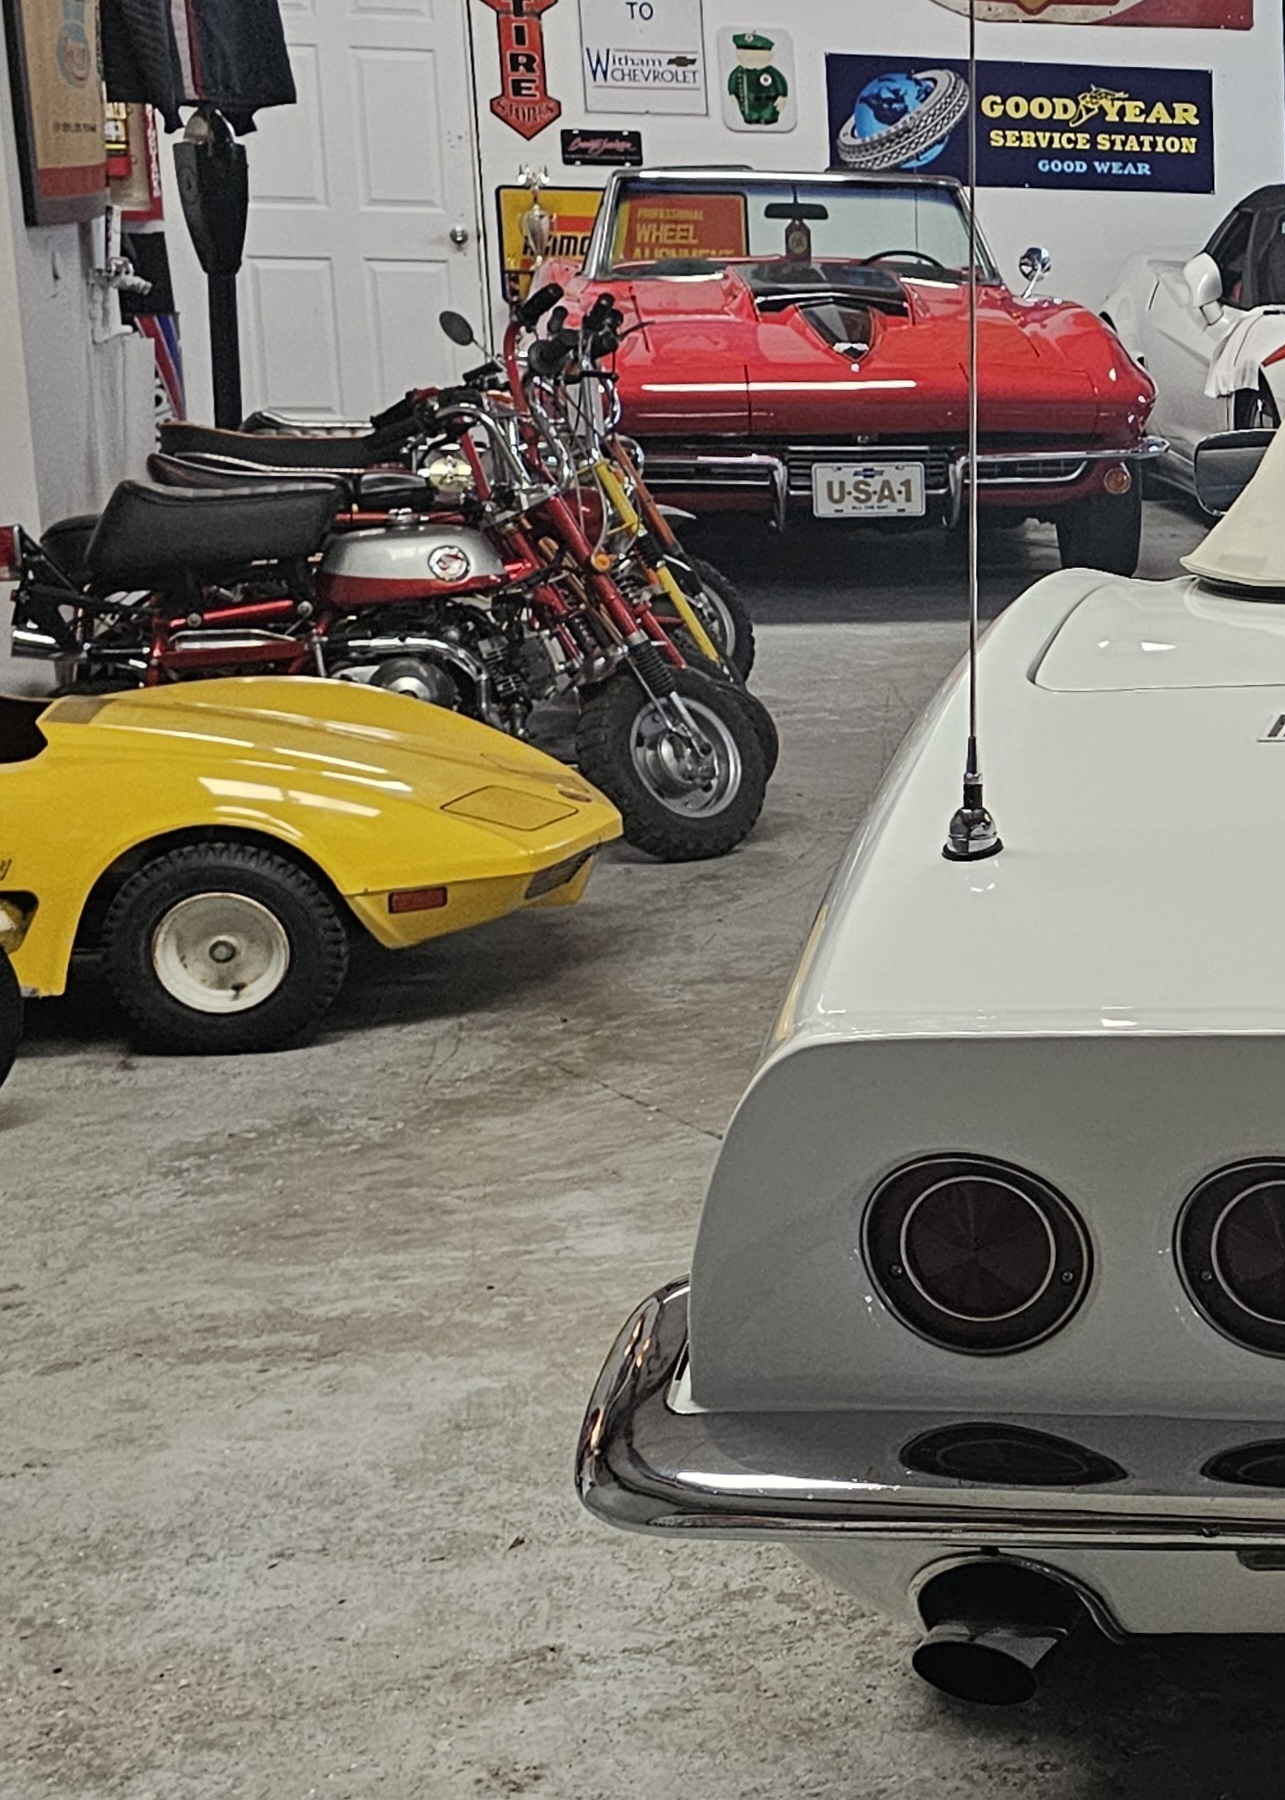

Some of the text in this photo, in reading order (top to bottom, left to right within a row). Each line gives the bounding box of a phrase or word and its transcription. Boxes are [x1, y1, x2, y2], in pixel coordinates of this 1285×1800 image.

[628, 2, 654, 20] TO
[610, 67, 699, 84] CHEVROLET
[990, 130, 1198, 154] SERVICE STATION
[1038, 160, 1152, 176] GOOD WEAR
[636, 222, 699, 244] WHEEL
